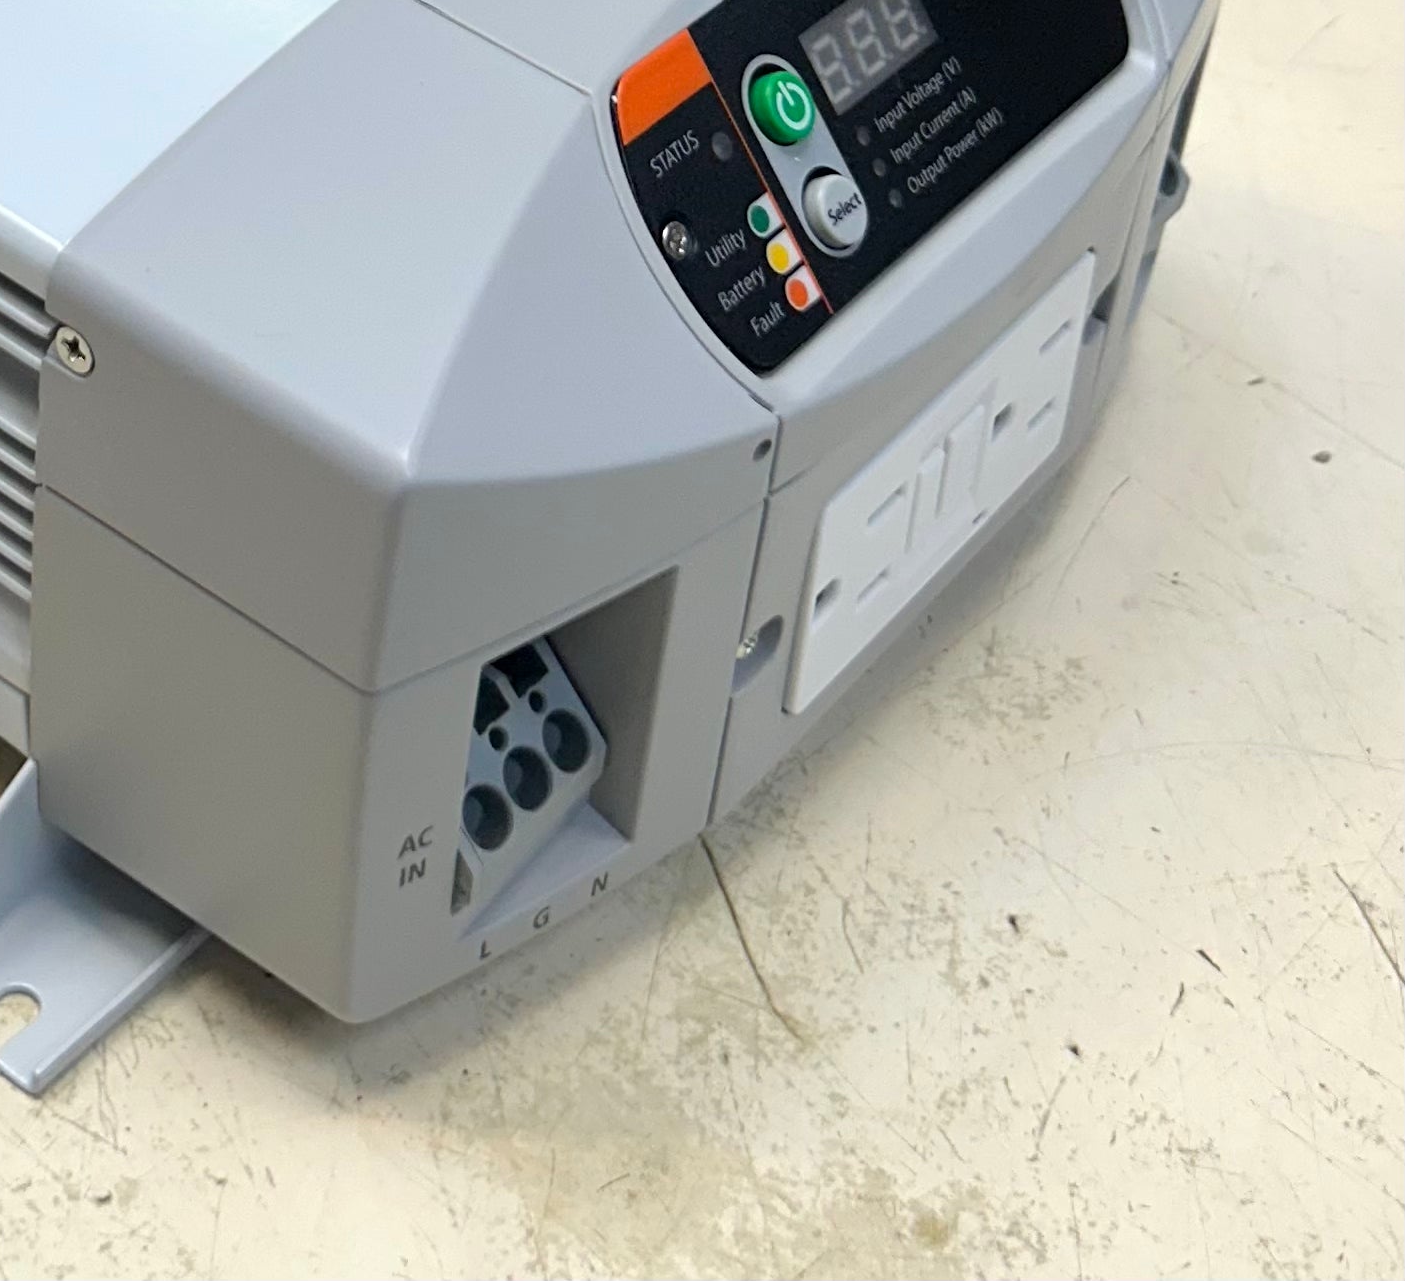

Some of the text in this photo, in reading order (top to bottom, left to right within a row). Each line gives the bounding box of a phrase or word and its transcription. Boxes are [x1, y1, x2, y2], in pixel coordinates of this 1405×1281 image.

[873, 56, 963, 133] Input Voltage (V)
[889, 86, 977, 164] Input Current (A)
[649, 129, 700, 179] STATUS
[907, 106, 1004, 194] Output Power (kW)
[827, 191, 863, 226] Select
[704, 228, 747, 268] Utility
[717, 266, 767, 312] Battery
[749, 300, 787, 338] Fault
[398, 825, 434, 860] AC
[399, 858, 427, 888] IN
[478, 872, 609, 960] L G N
